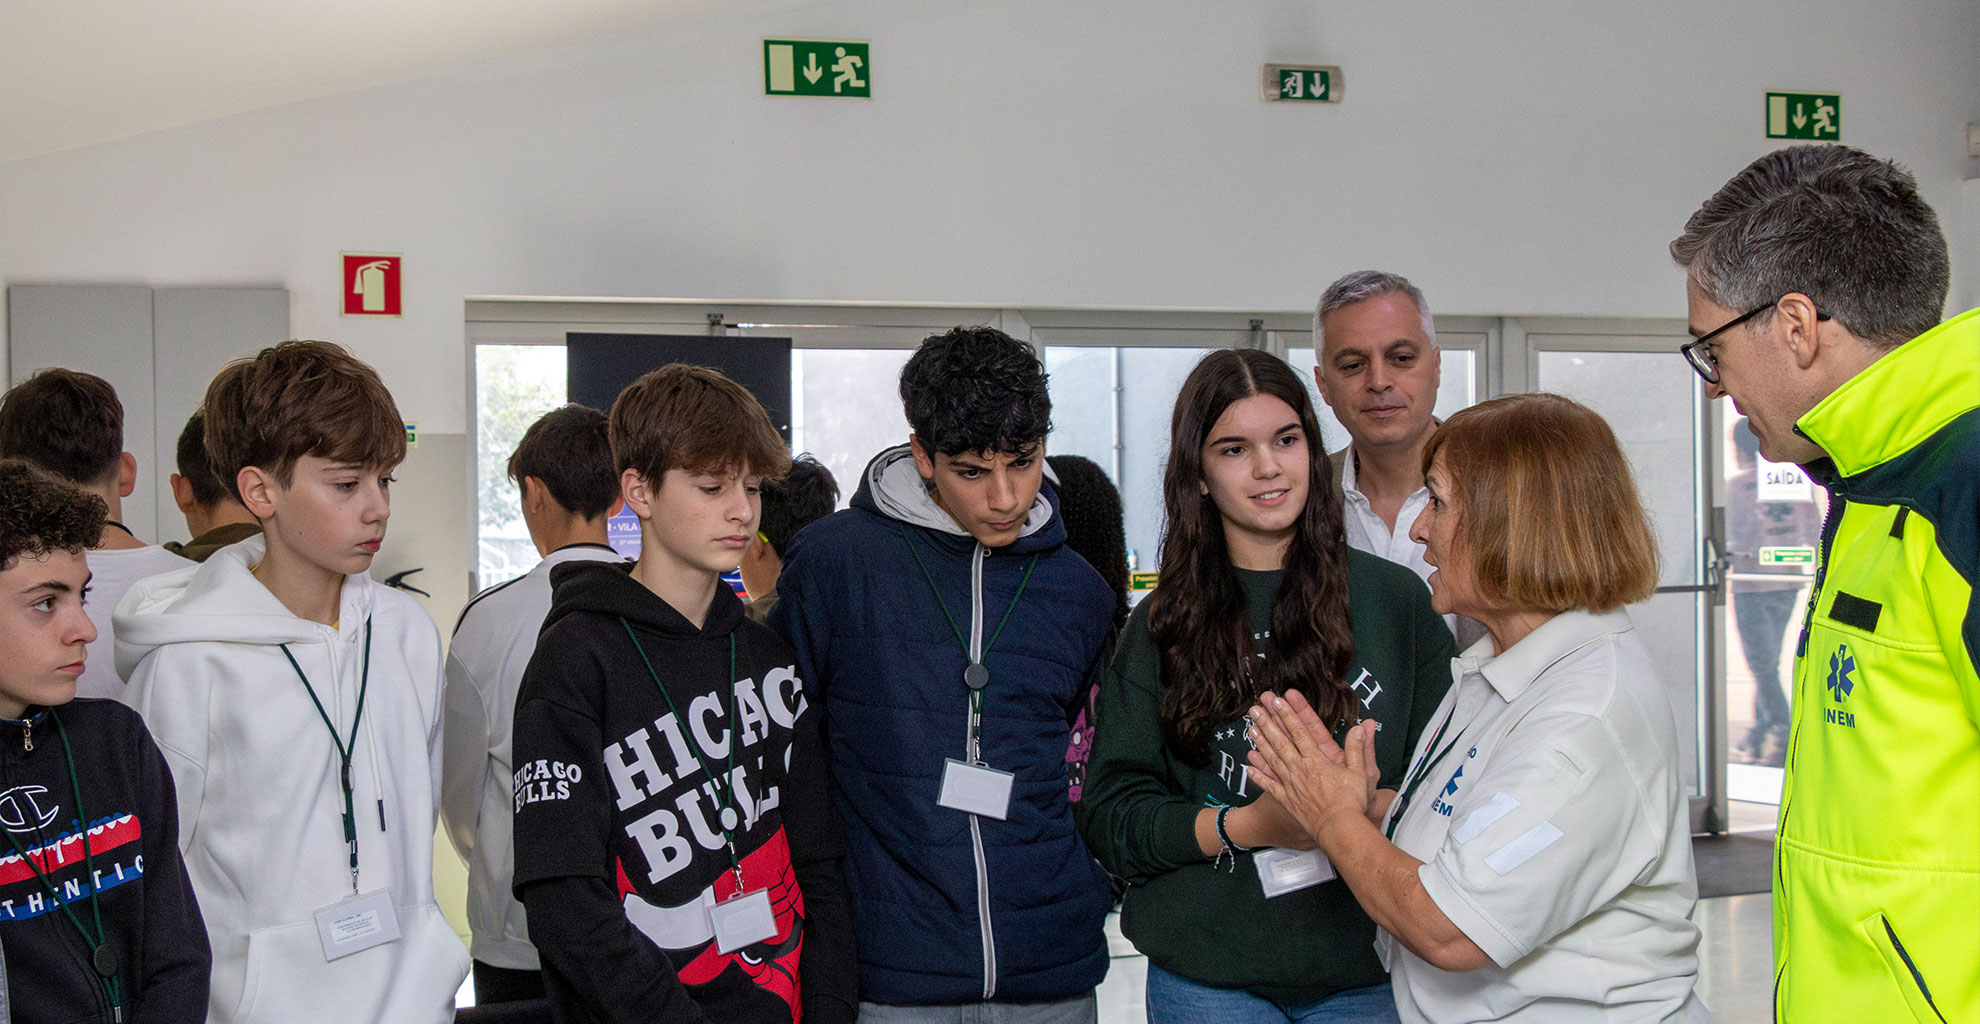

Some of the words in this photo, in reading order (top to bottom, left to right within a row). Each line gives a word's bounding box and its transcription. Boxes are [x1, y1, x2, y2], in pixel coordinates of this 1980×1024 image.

[1767, 469, 1804, 485] SAÍDA
[617, 523, 638, 532] VILA
[515, 780, 571, 814] BULLS
